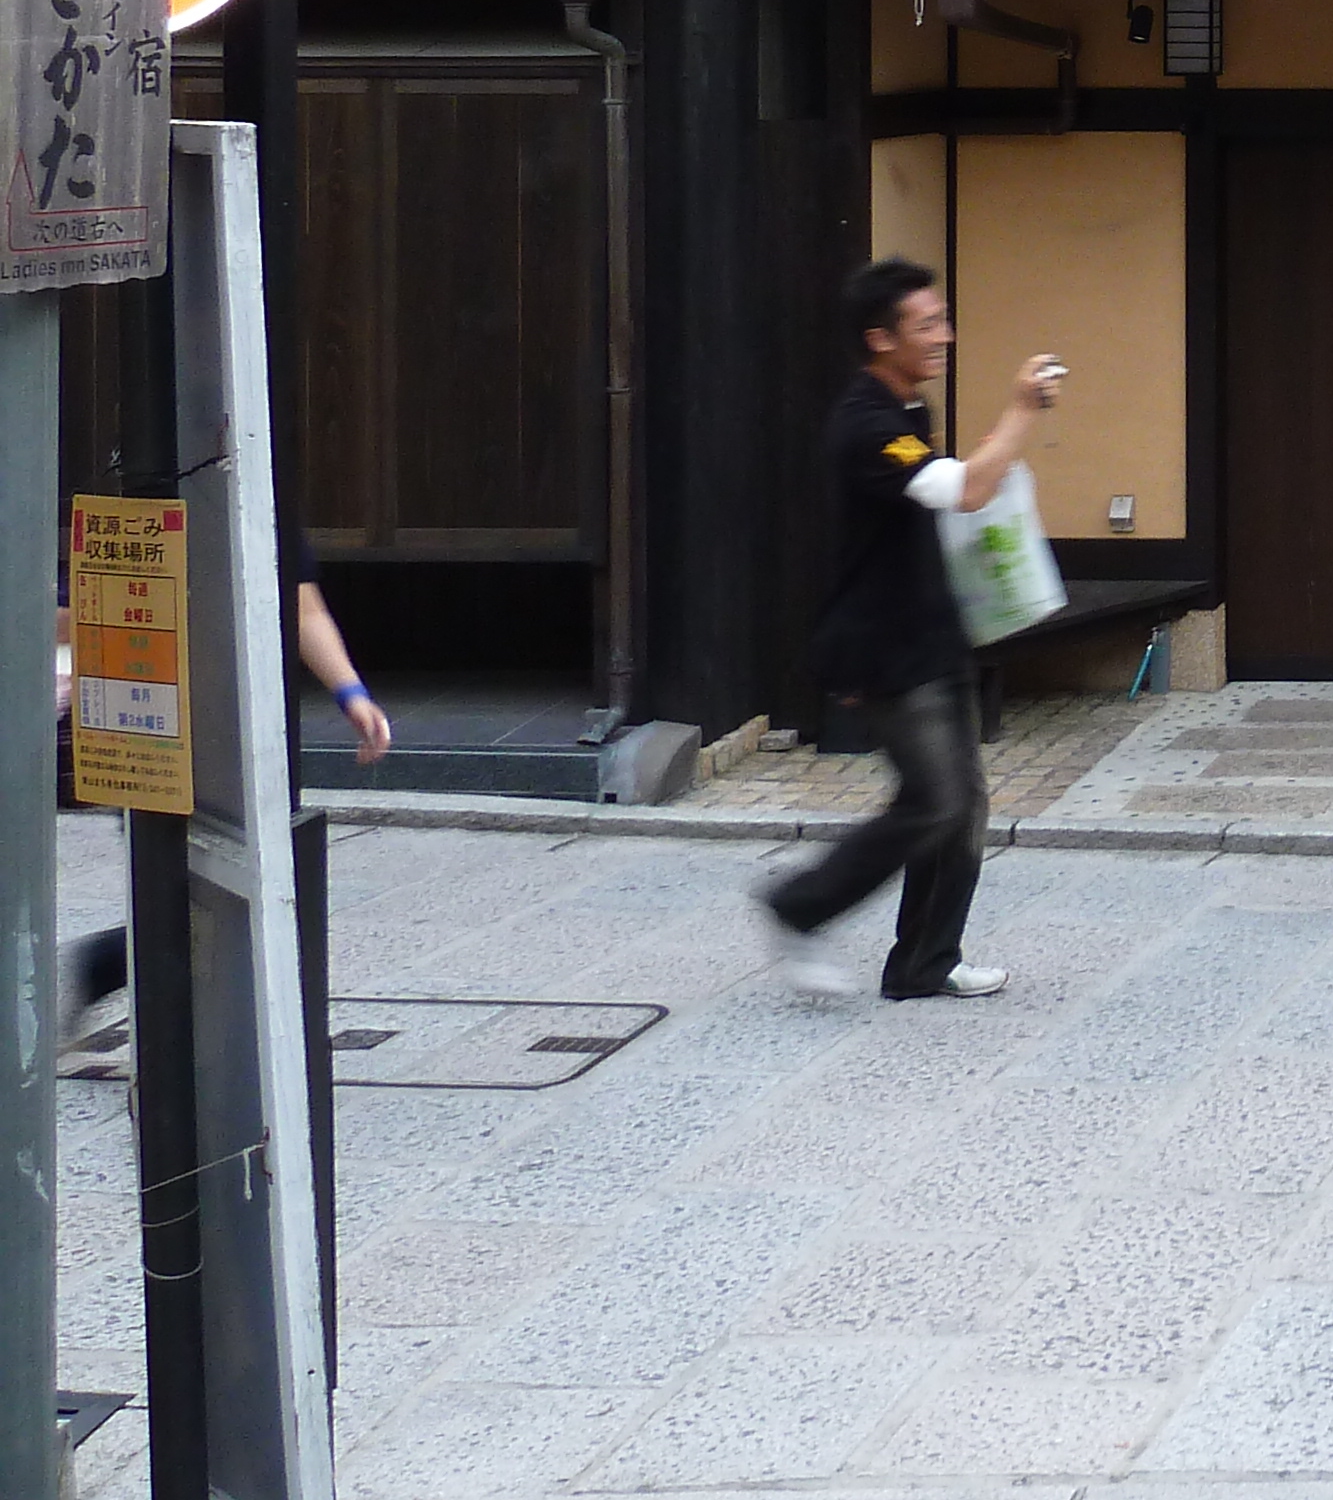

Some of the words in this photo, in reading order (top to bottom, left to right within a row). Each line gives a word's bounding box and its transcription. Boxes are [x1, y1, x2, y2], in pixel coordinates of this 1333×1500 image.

[33, 215, 124, 244] 次の道右へ
[1, 260, 56, 280] Ladies
[91, 251, 150, 271] SAKATA
[86, 513, 164, 538] 資源ごみ
[85, 540, 165, 563] 収集場所
